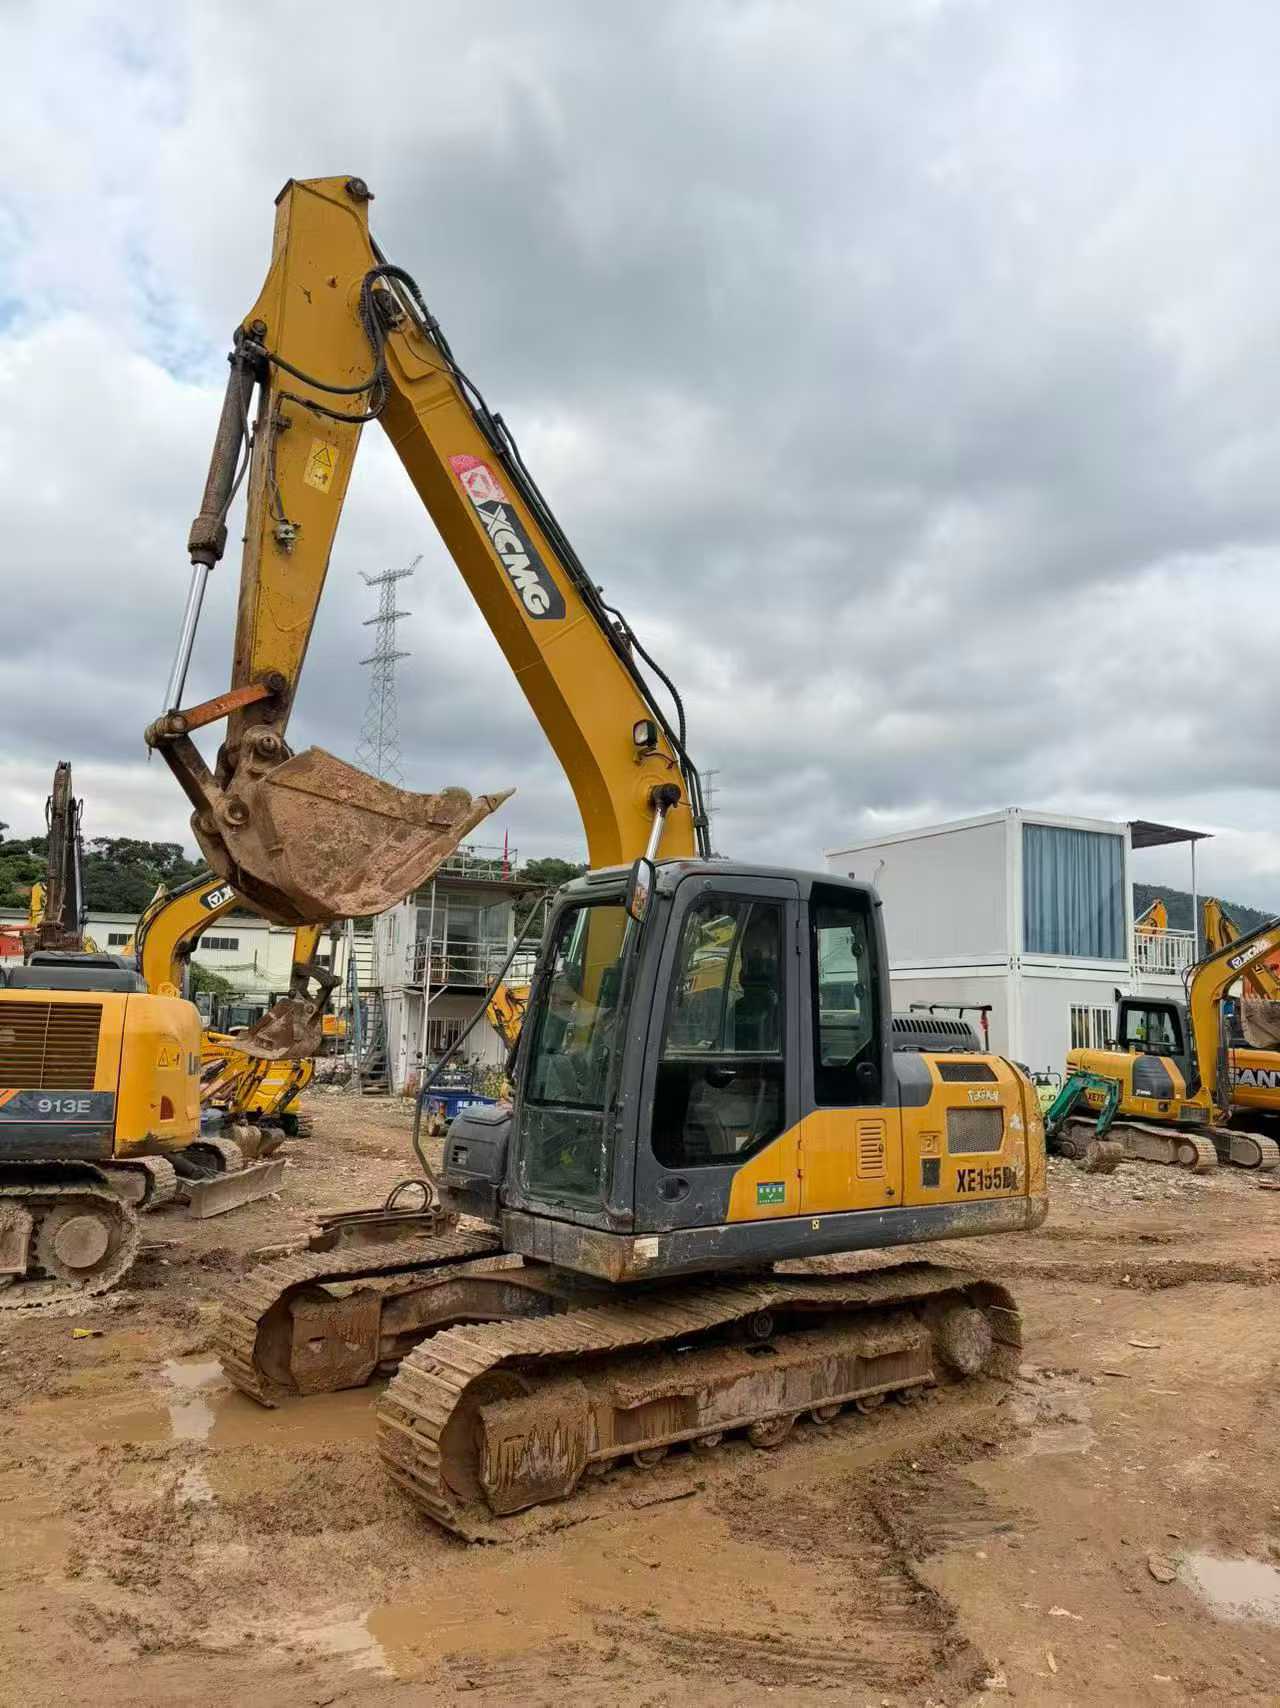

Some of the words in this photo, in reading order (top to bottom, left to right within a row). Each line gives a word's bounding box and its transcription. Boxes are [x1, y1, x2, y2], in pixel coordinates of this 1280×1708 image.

[476, 504, 550, 615] XCMG
[1228, 1069, 1280, 1088] SAN
[38, 1099, 91, 1113] 913E
